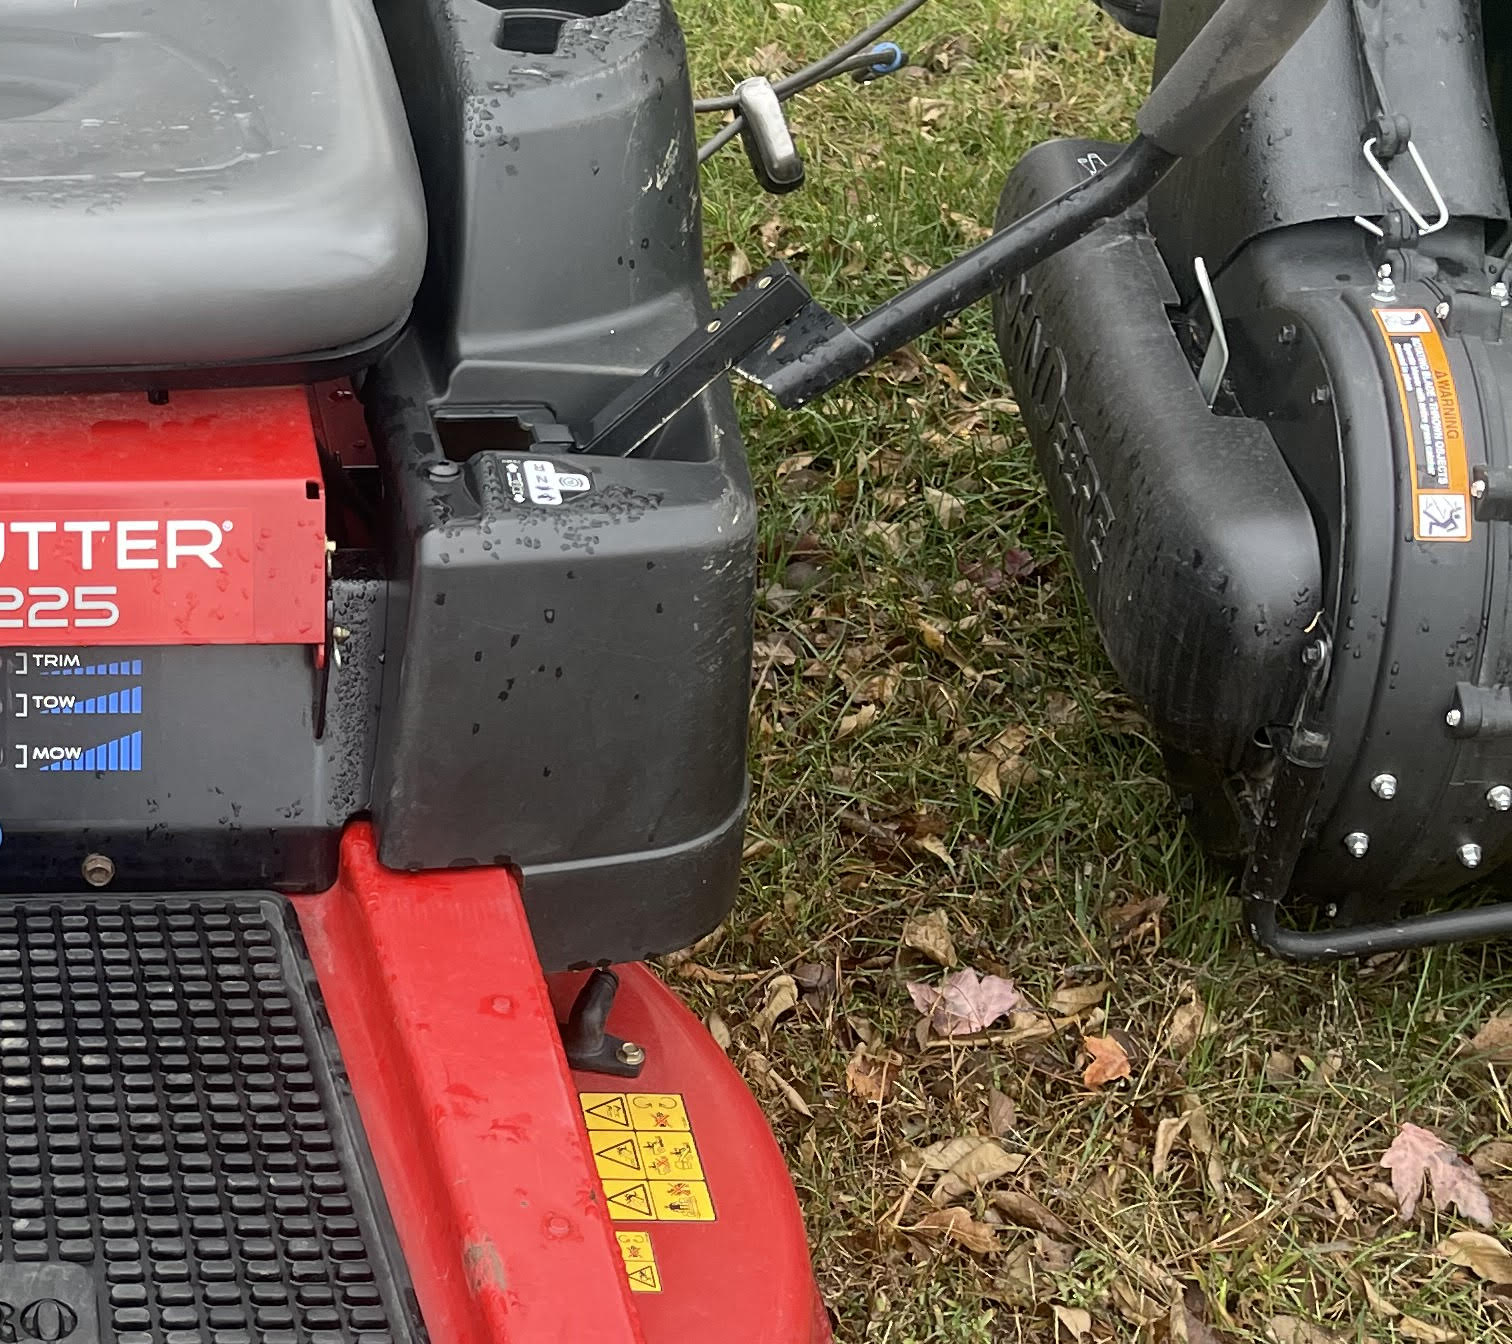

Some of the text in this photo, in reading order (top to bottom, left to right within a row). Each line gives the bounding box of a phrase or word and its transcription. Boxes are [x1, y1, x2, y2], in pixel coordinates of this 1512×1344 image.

[1429, 402, 1443, 440] THROWN
[1436, 379, 1459, 439] WARNING
[1435, 441, 1448, 484] OBJECTS
[32, 654, 80, 667] TRIM
[32, 695, 76, 708] TOW
[32, 747, 82, 759] MOW
